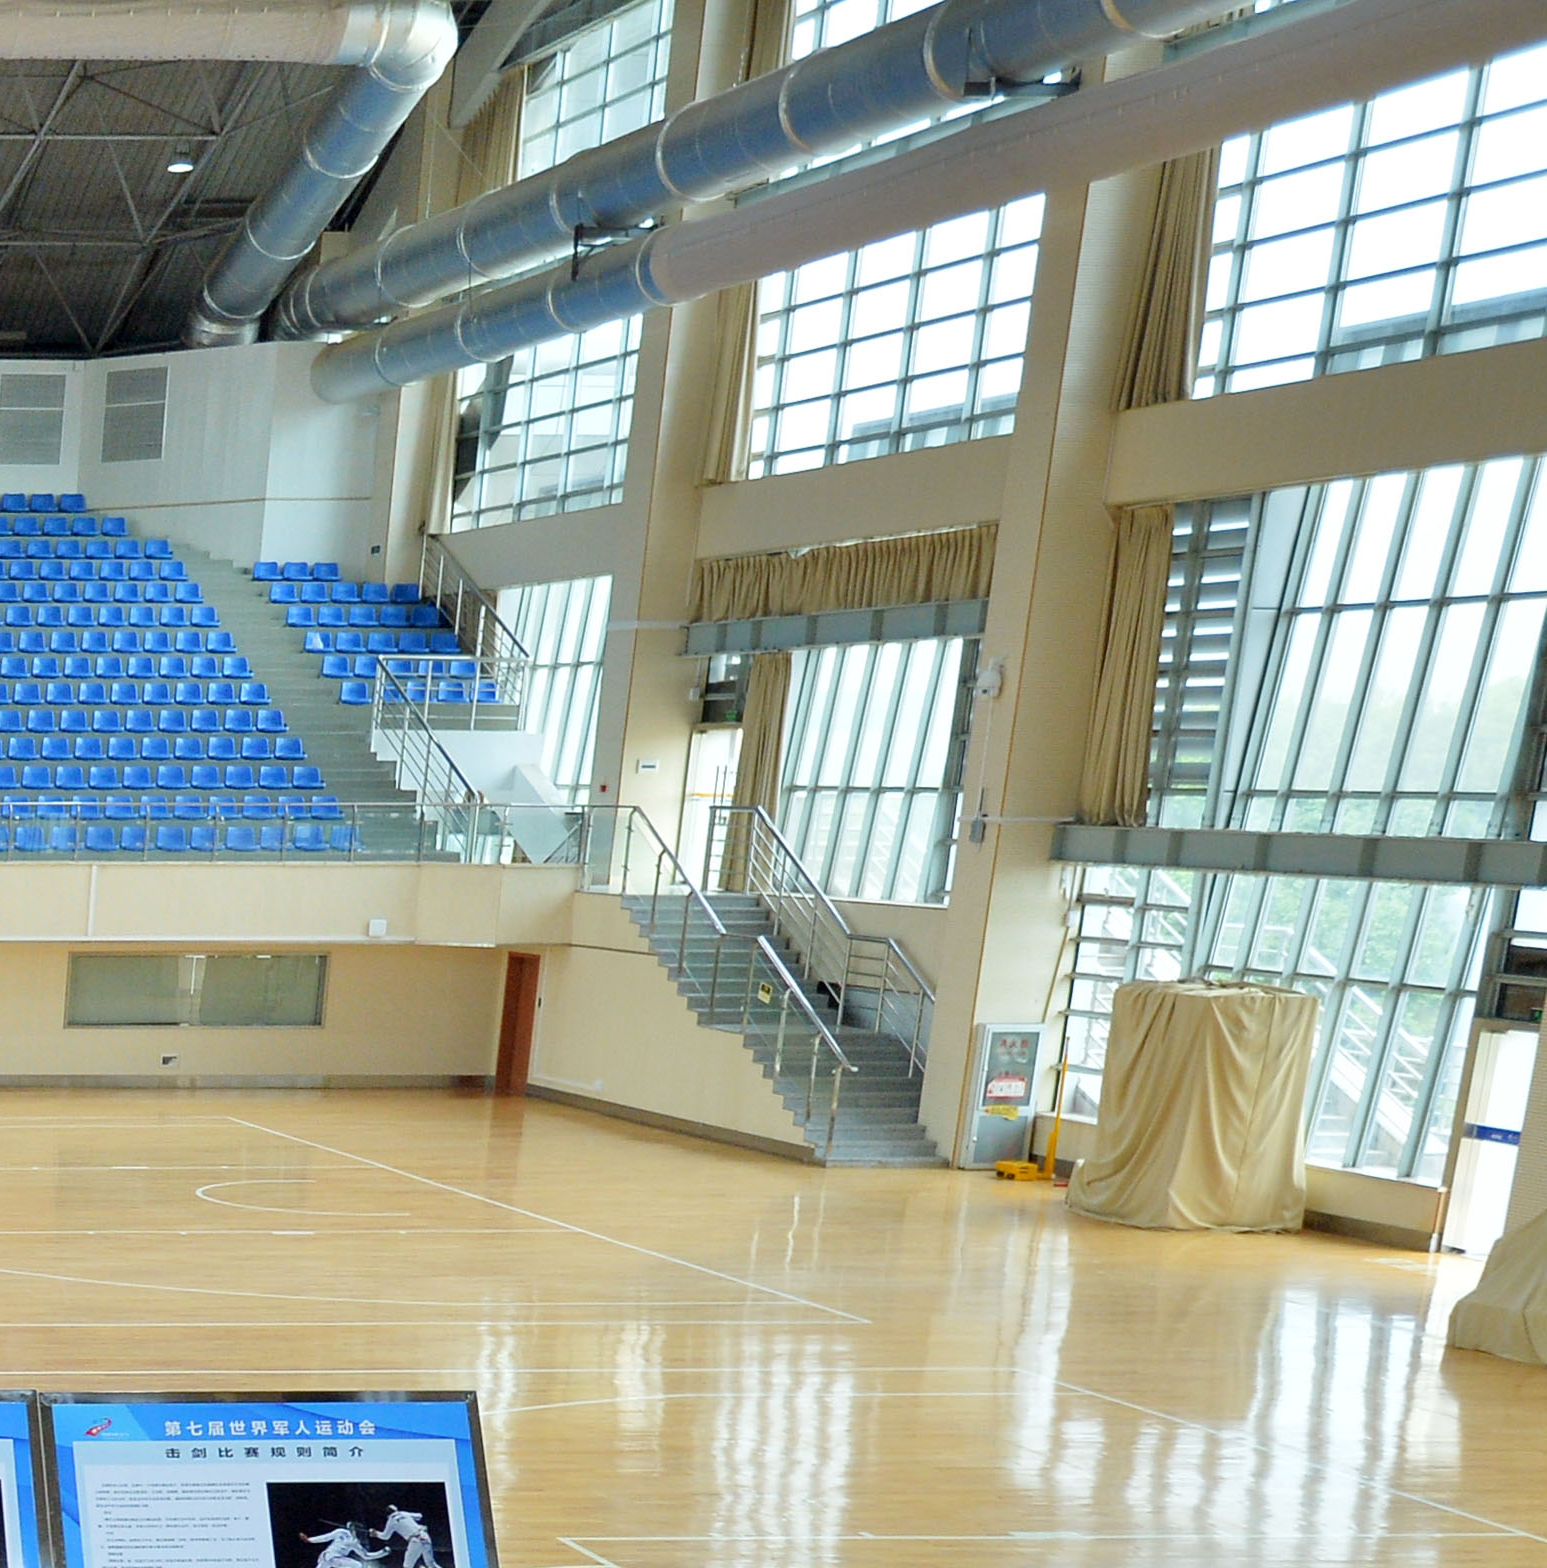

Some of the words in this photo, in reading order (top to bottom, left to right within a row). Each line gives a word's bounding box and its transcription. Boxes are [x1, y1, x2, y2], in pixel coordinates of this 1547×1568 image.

[164, 1419, 377, 1437] 第七届世界军人运动会
[165, 1446, 366, 1460] 击剑比赛规则简介
